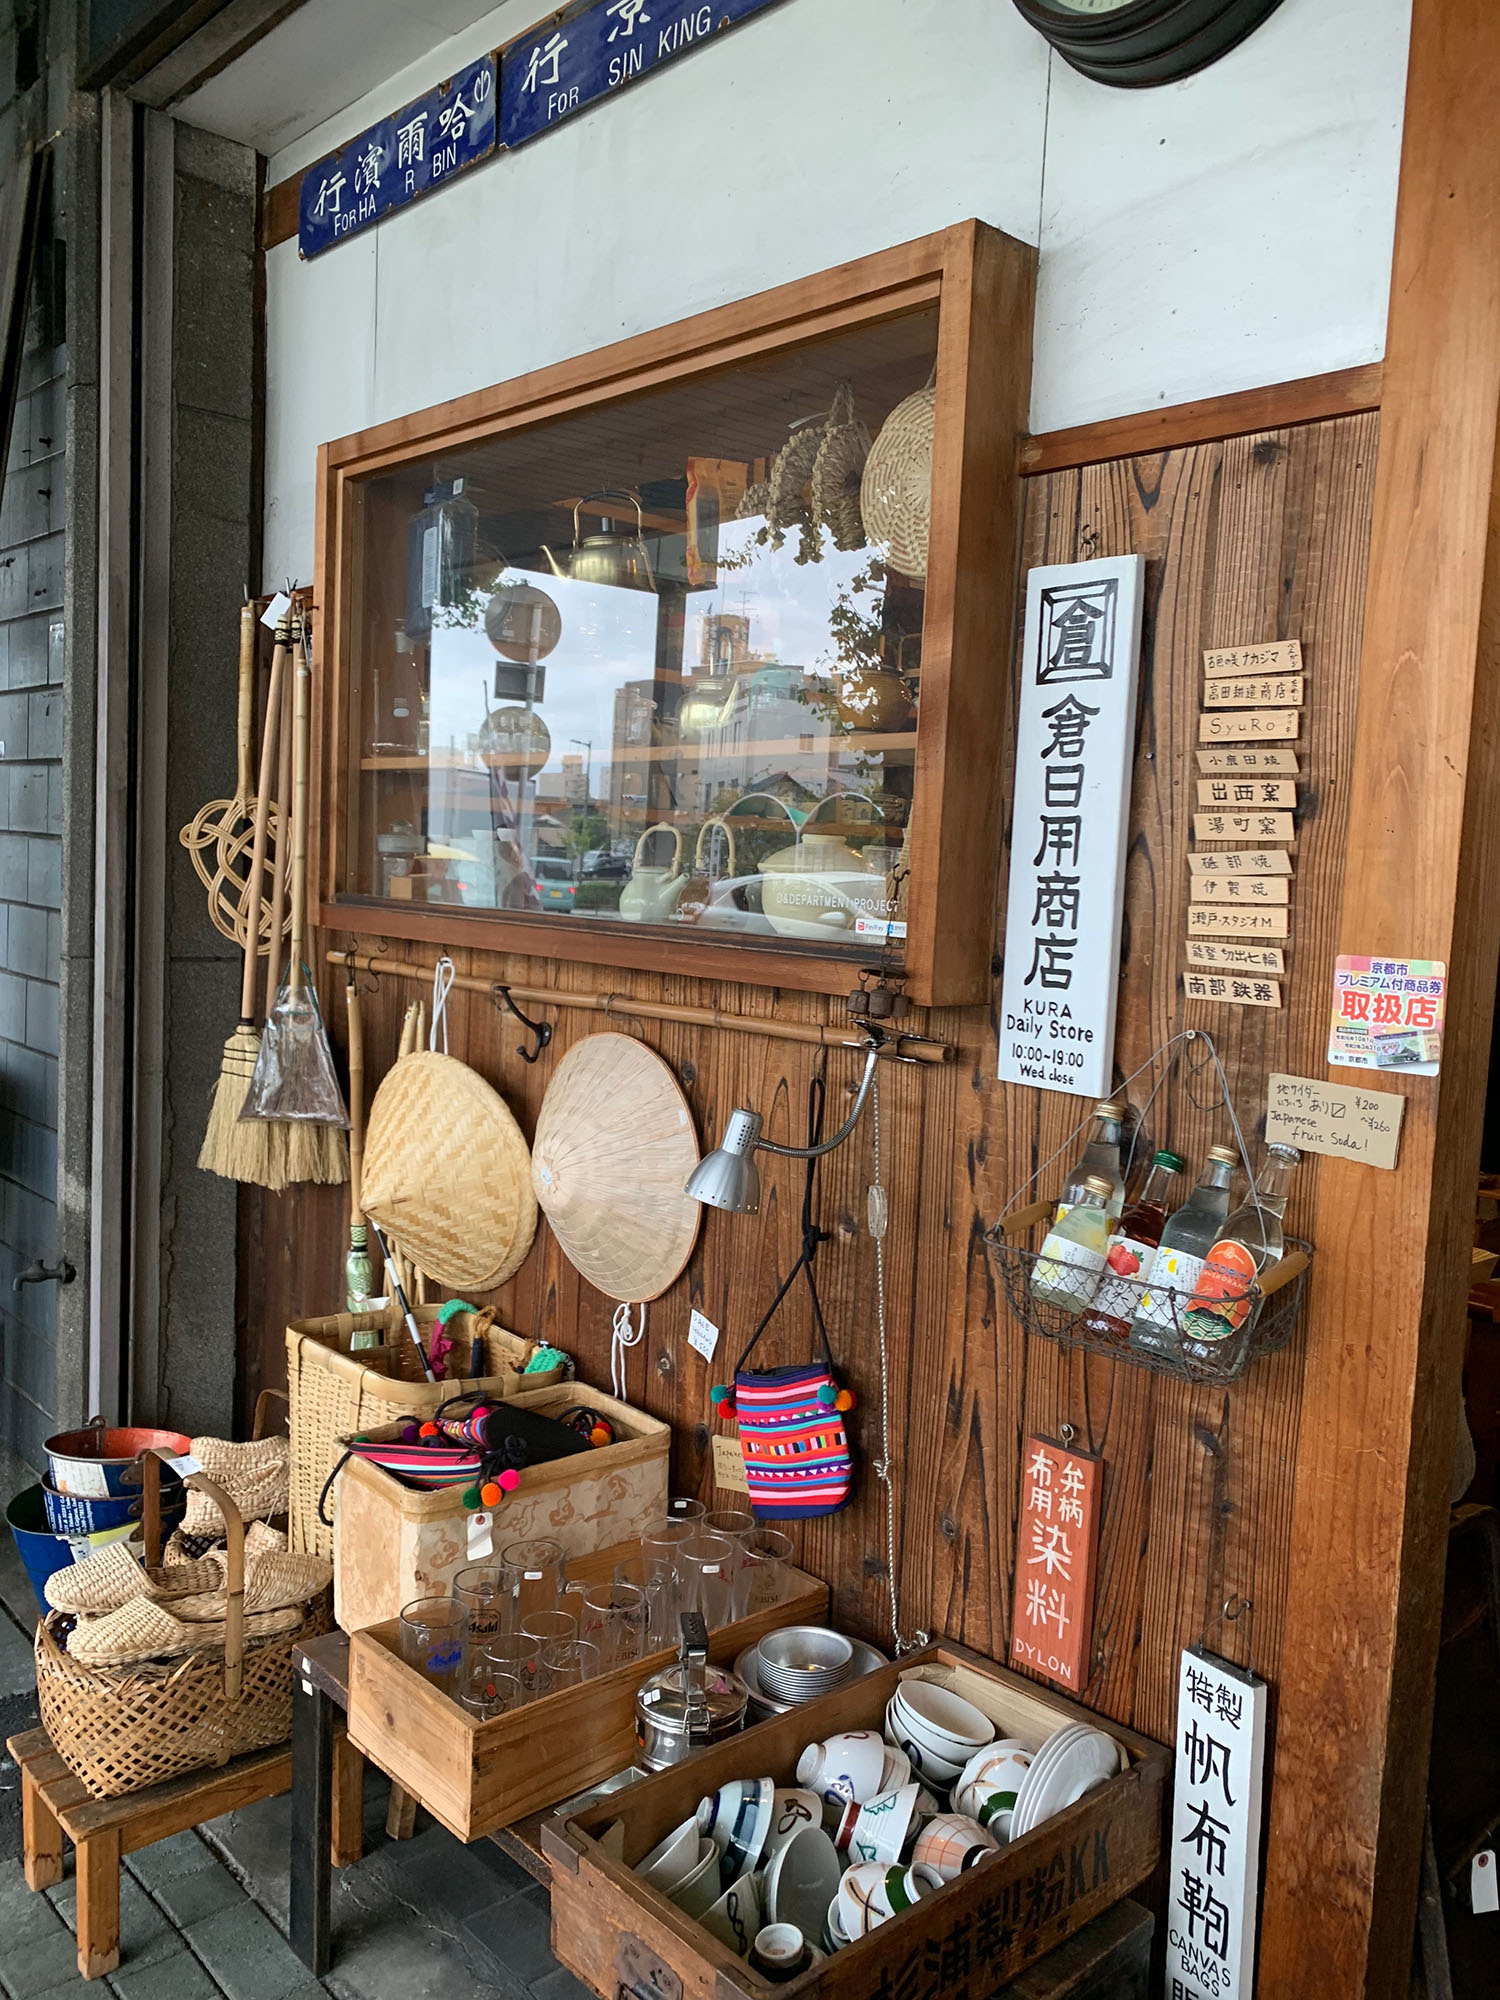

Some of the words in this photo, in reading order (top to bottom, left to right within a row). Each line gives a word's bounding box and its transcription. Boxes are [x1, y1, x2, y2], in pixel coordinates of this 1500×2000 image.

[547, 86, 579, 120] FOR
[608, 43, 643, 86] SIN
[658, 5, 711, 58] KING
[432, 142, 457, 178] BIN
[1209, 717, 1276, 736] SyuRo
[1211, 781, 1280, 802] 出西窯
[1207, 816, 1276, 835] 湯町窯
[1023, 693, 1100, 990] 倉日用商店
[1203, 879, 1269, 897] 伊賀焼
[854, 897, 900, 912] PROJECT
[1371, 961, 1408, 976] 京都市
[1189, 976, 1274, 1002] 南部鉄器
[1338, 974, 1442, 994] プレミアム付商品券
[1023, 998, 1073, 1020] KURA
[1340, 990, 1437, 1028] 取扱店
[1006, 1014, 1043, 1039] Daily
[1049, 1020, 1094, 1043] Store
[1048, 1067, 1075, 1085] close
[1276, 1083, 1320, 1099] 地サイダー
[1270, 1110, 1317, 1127] Japanese
[1291, 1126, 1324, 1143] fruit
[1026, 1448, 1054, 1520] 布用
[1026, 1517, 1073, 1640] 染料
[468, 1620, 498, 1633] Asahi
[1015, 1637, 1072, 1679] DYLON
[1185, 1665, 1243, 1730] 特製
[1177, 1718, 1237, 1961] 帆布鞄
[1169, 1928, 1231, 1988] CANVAS
[1181, 1955, 1220, 1998] BAGS
